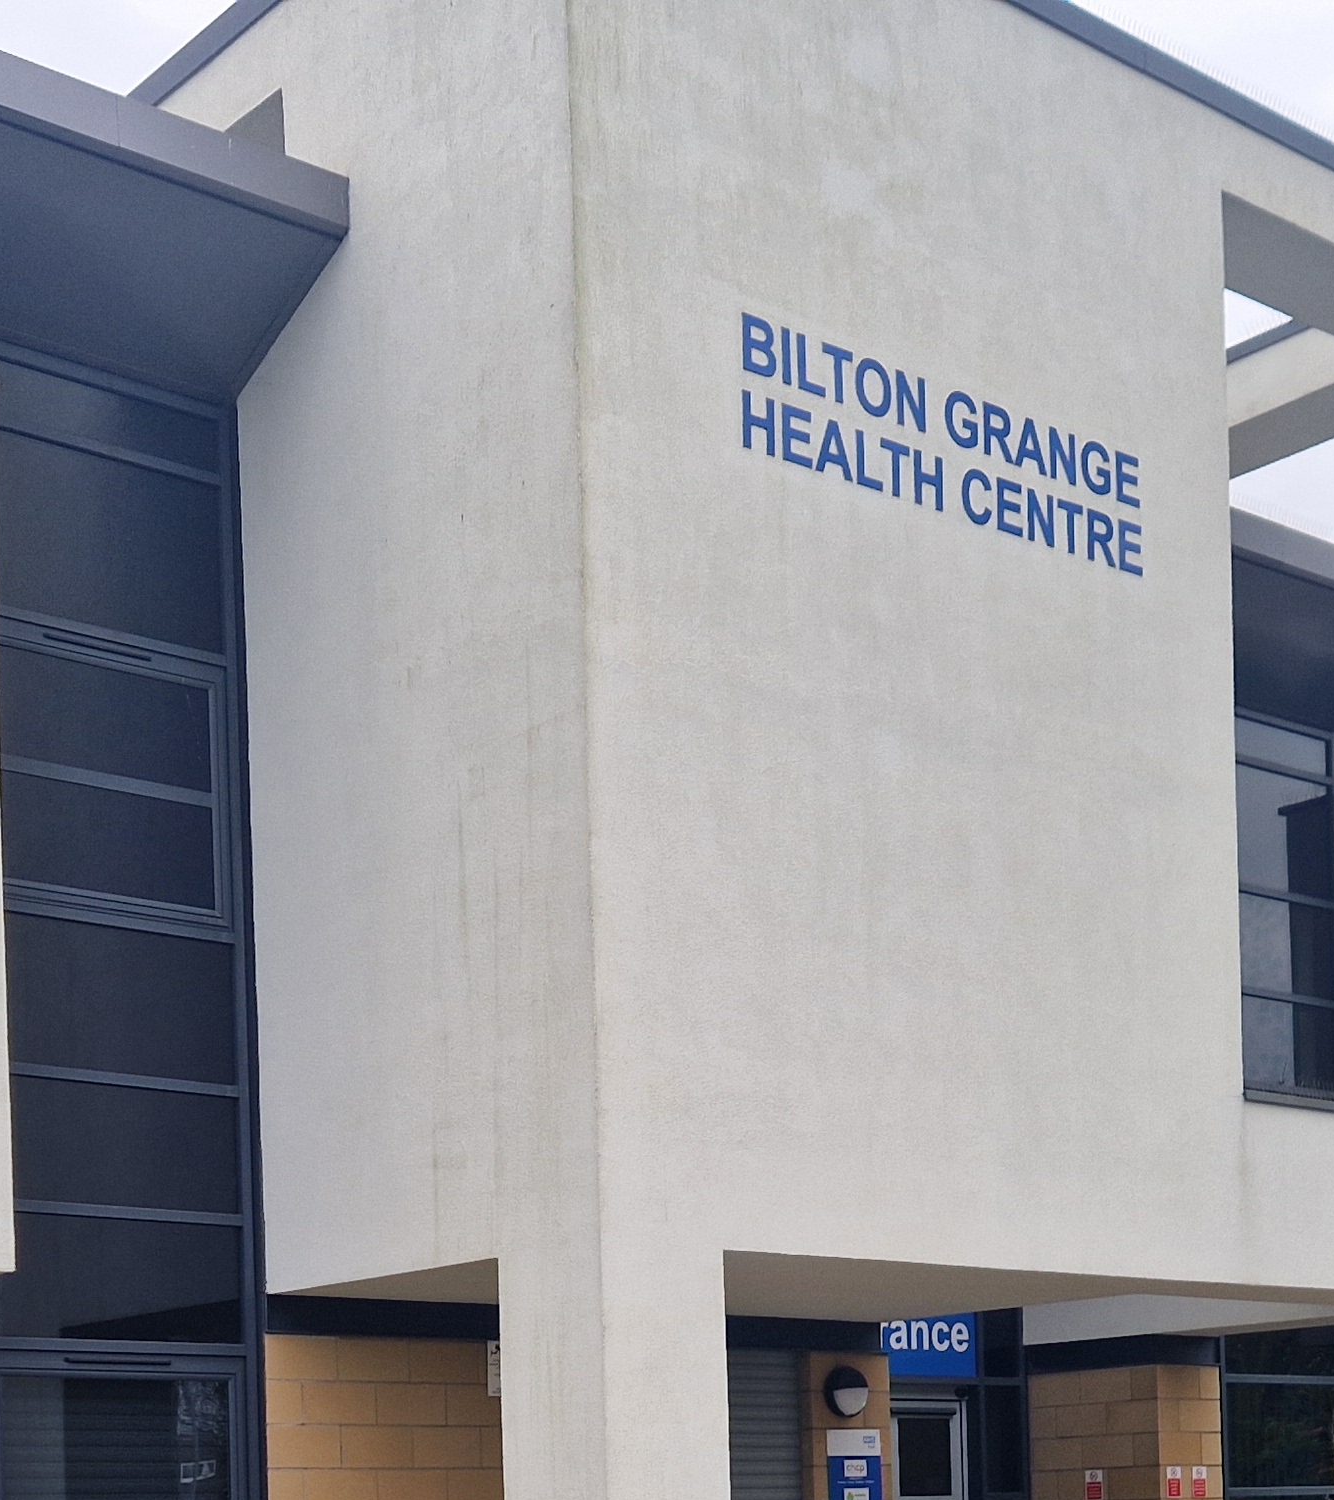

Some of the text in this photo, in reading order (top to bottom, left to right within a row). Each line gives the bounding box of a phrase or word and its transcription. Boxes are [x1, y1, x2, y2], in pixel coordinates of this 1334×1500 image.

[741, 311, 1141, 509] BILTON GRANGE
[741, 388, 1144, 577] HEALTH CENTRE
